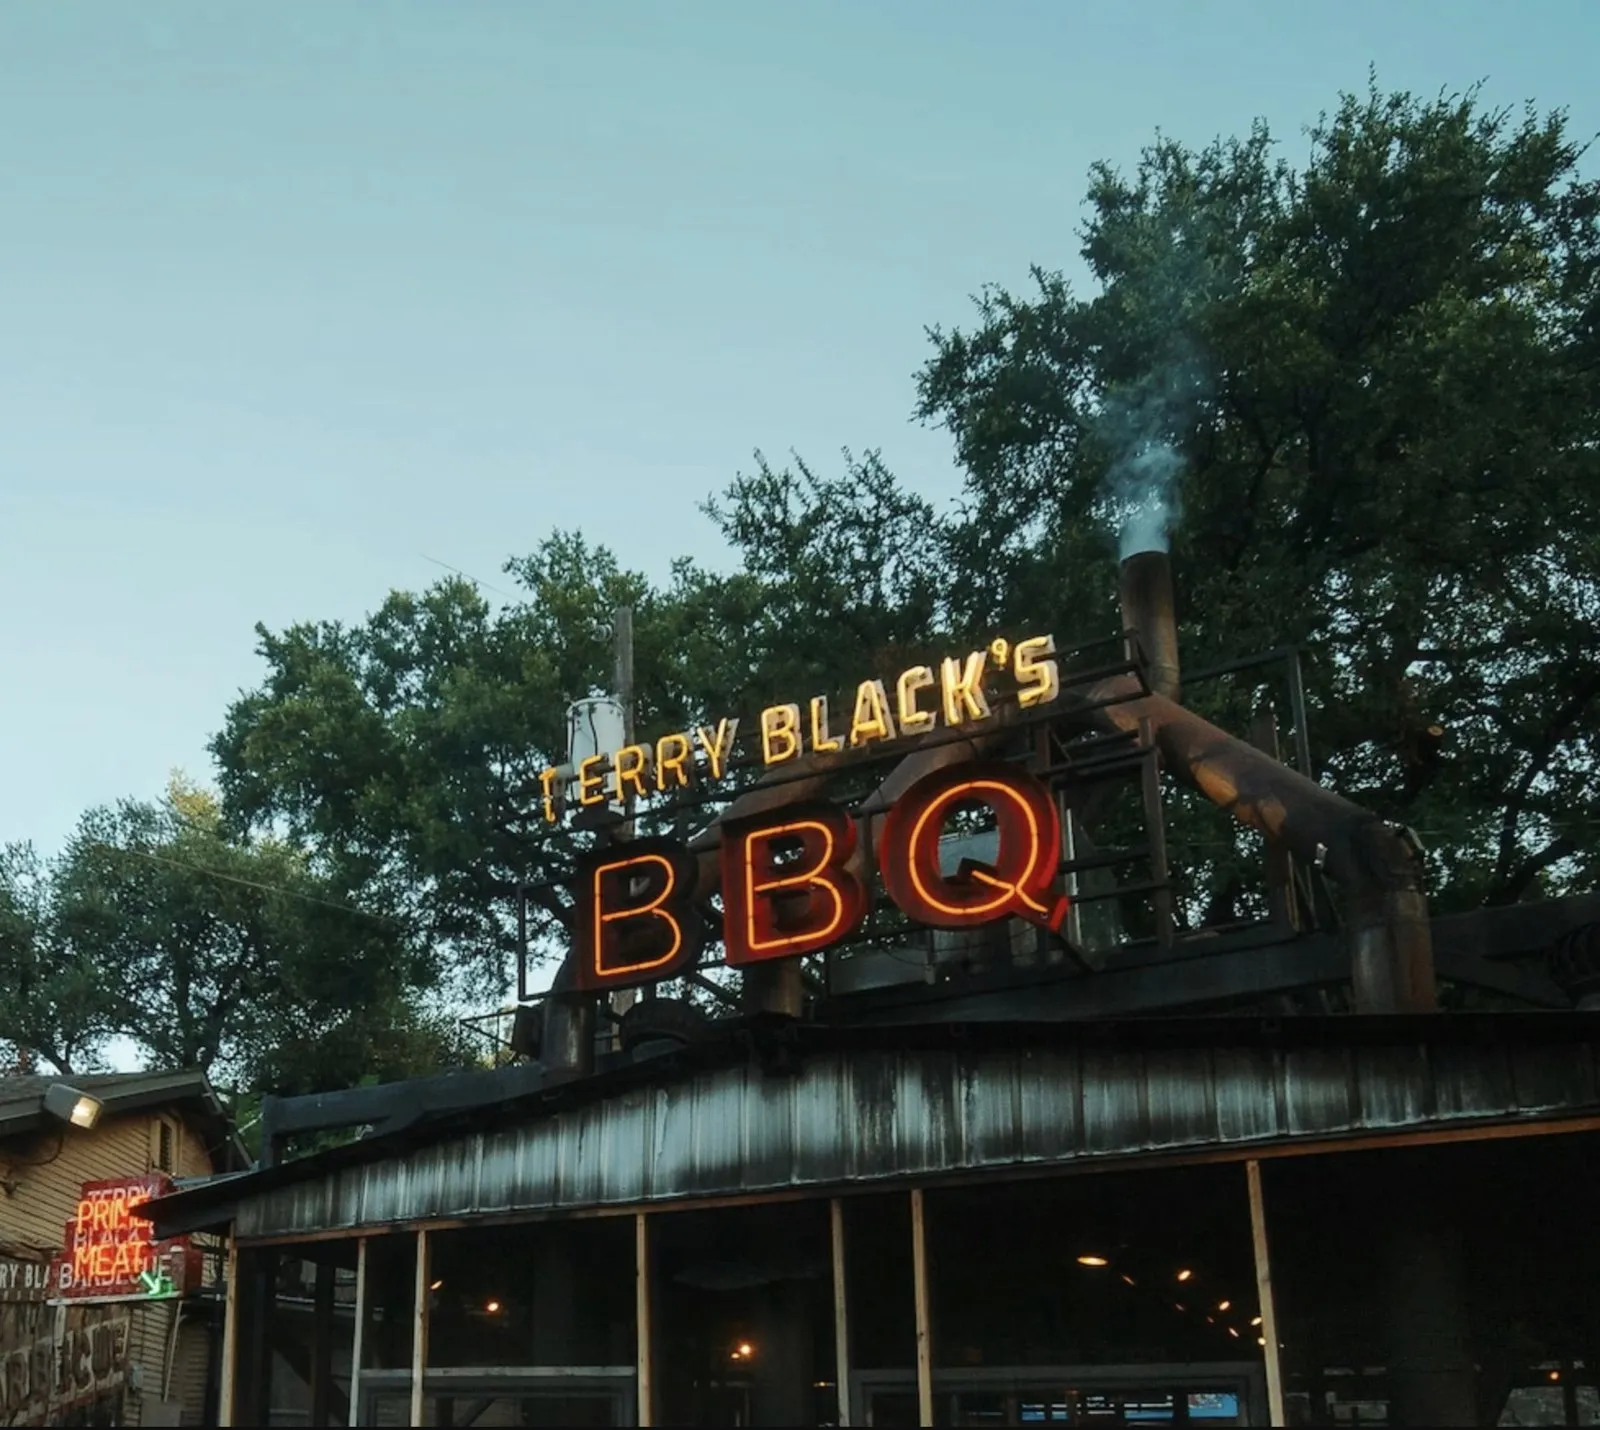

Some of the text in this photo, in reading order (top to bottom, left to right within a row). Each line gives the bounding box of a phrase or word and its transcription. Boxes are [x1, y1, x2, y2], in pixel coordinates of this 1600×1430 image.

[539, 634, 1060, 822] TERRY BLACK'S
[580, 766, 1067, 987] BBQ
[73, 1239, 148, 1279] MEAT
